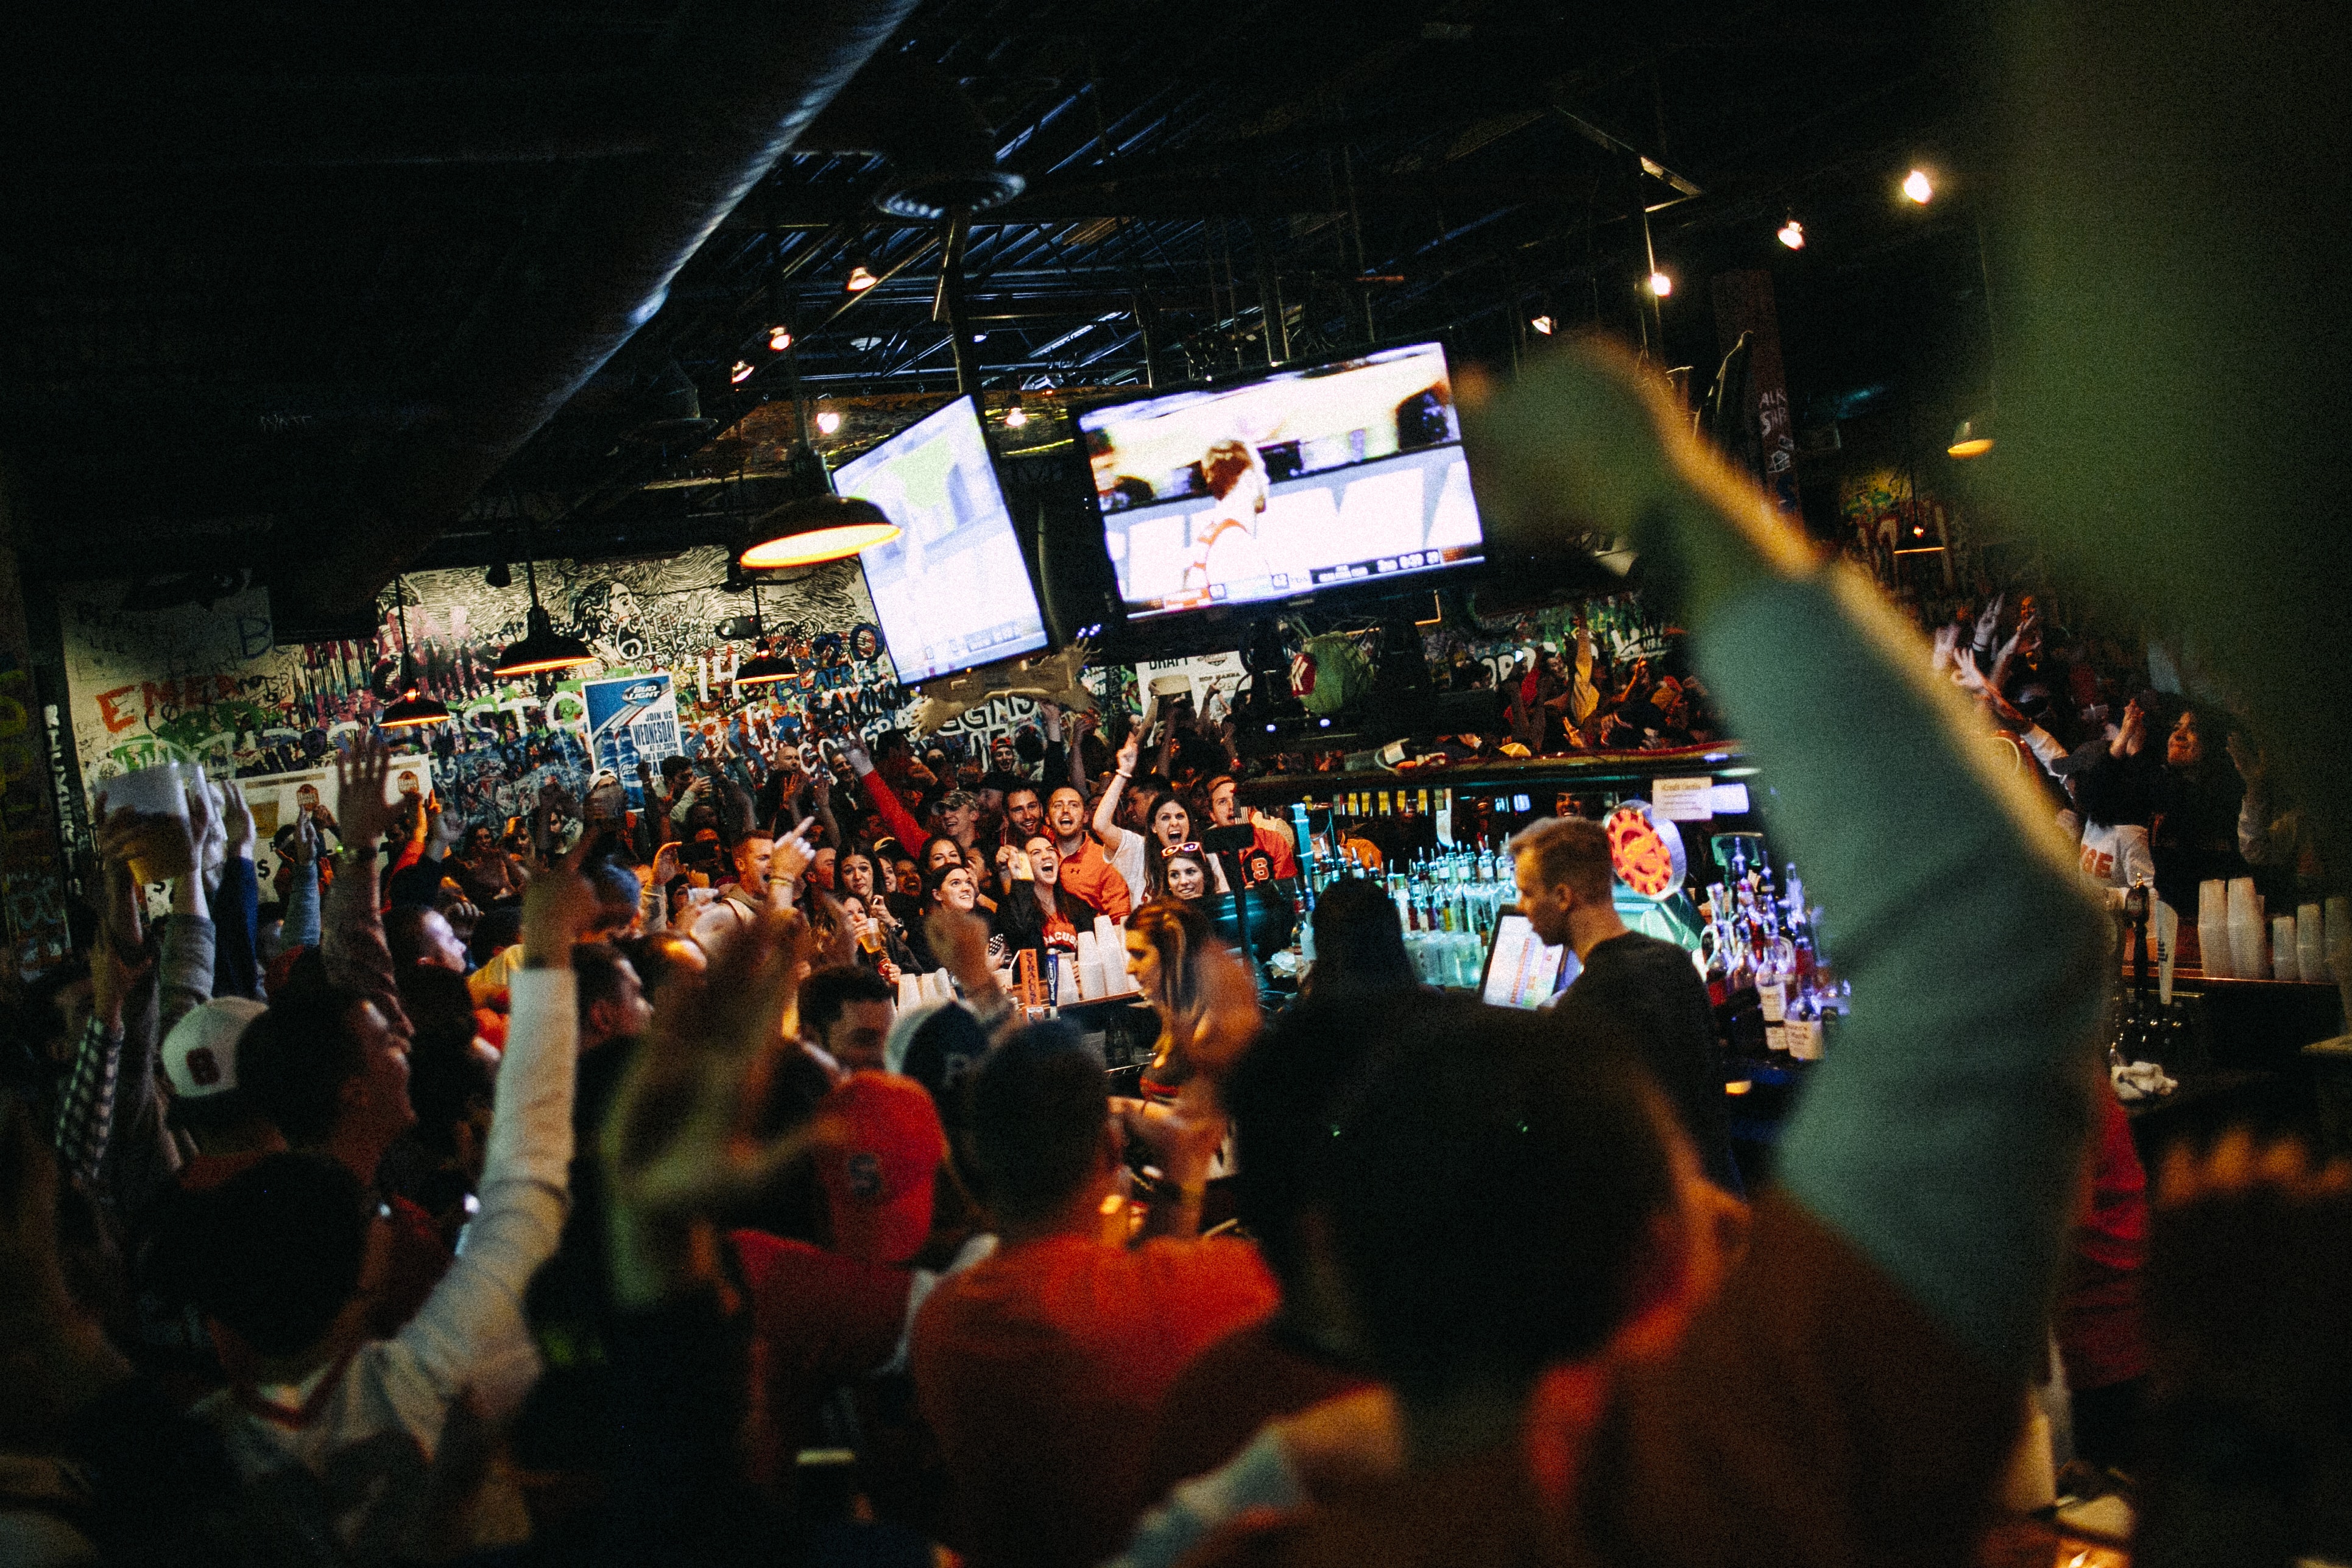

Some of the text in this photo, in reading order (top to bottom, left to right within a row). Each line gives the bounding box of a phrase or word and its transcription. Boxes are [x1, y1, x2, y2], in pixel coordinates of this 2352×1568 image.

[629, 691, 660, 700] LIGHT
[634, 685, 657, 693] BUD
[645, 711, 673, 722] JOIN US
[632, 721, 676, 747] WEDNESDAY
[257, 859, 270, 880] $
[1251, 856, 1270, 881] S
[1025, 951, 1037, 1005] SYRACUSE
